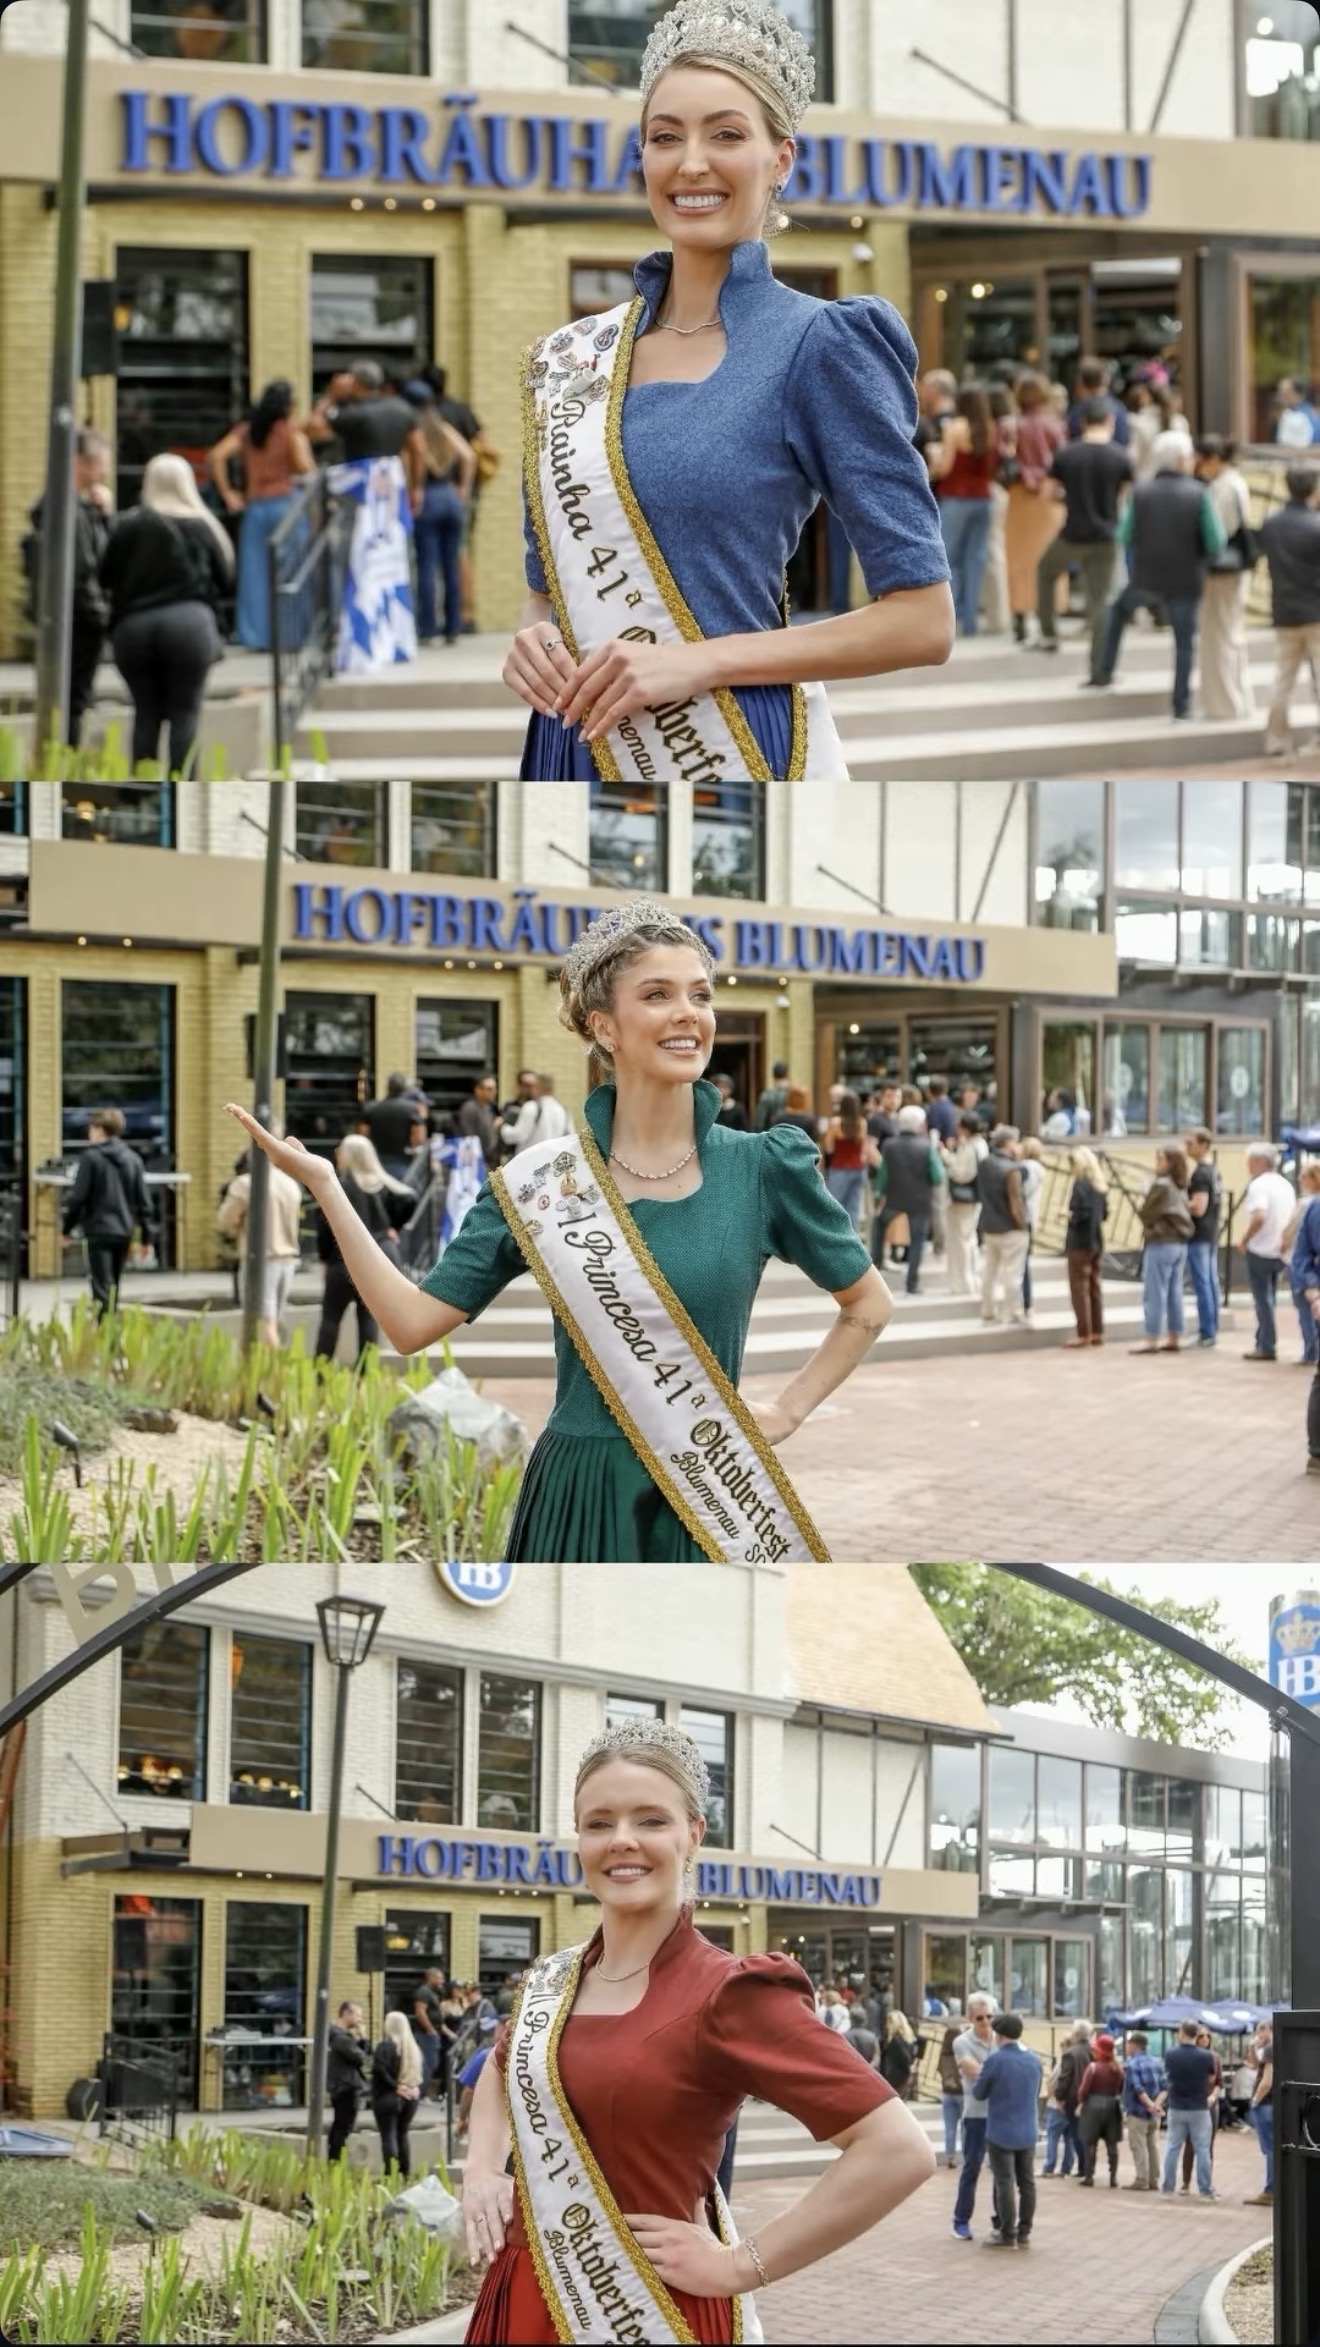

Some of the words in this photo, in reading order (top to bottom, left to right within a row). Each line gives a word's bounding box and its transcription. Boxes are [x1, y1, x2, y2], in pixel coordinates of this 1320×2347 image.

[119, 90, 642, 193] HOFBRÄUHA
[783, 133, 1154, 218] BLUMENAU
[550, 400, 593, 541] Rainha
[735, 919, 987, 982] BLUMENAU
[564, 1230, 657, 1363] Princesa
[690, 1418, 792, 1563] Oktoberfest
[670, 1451, 740, 1540] Blumenau
[1277, 1654, 1320, 1698] HB
[378, 1834, 584, 1887] HOFBRÄU
[697, 1861, 881, 1907] BLUMENAU
[516, 2011, 550, 2135] Princesa
[544, 2230, 592, 2330] Blumenau
